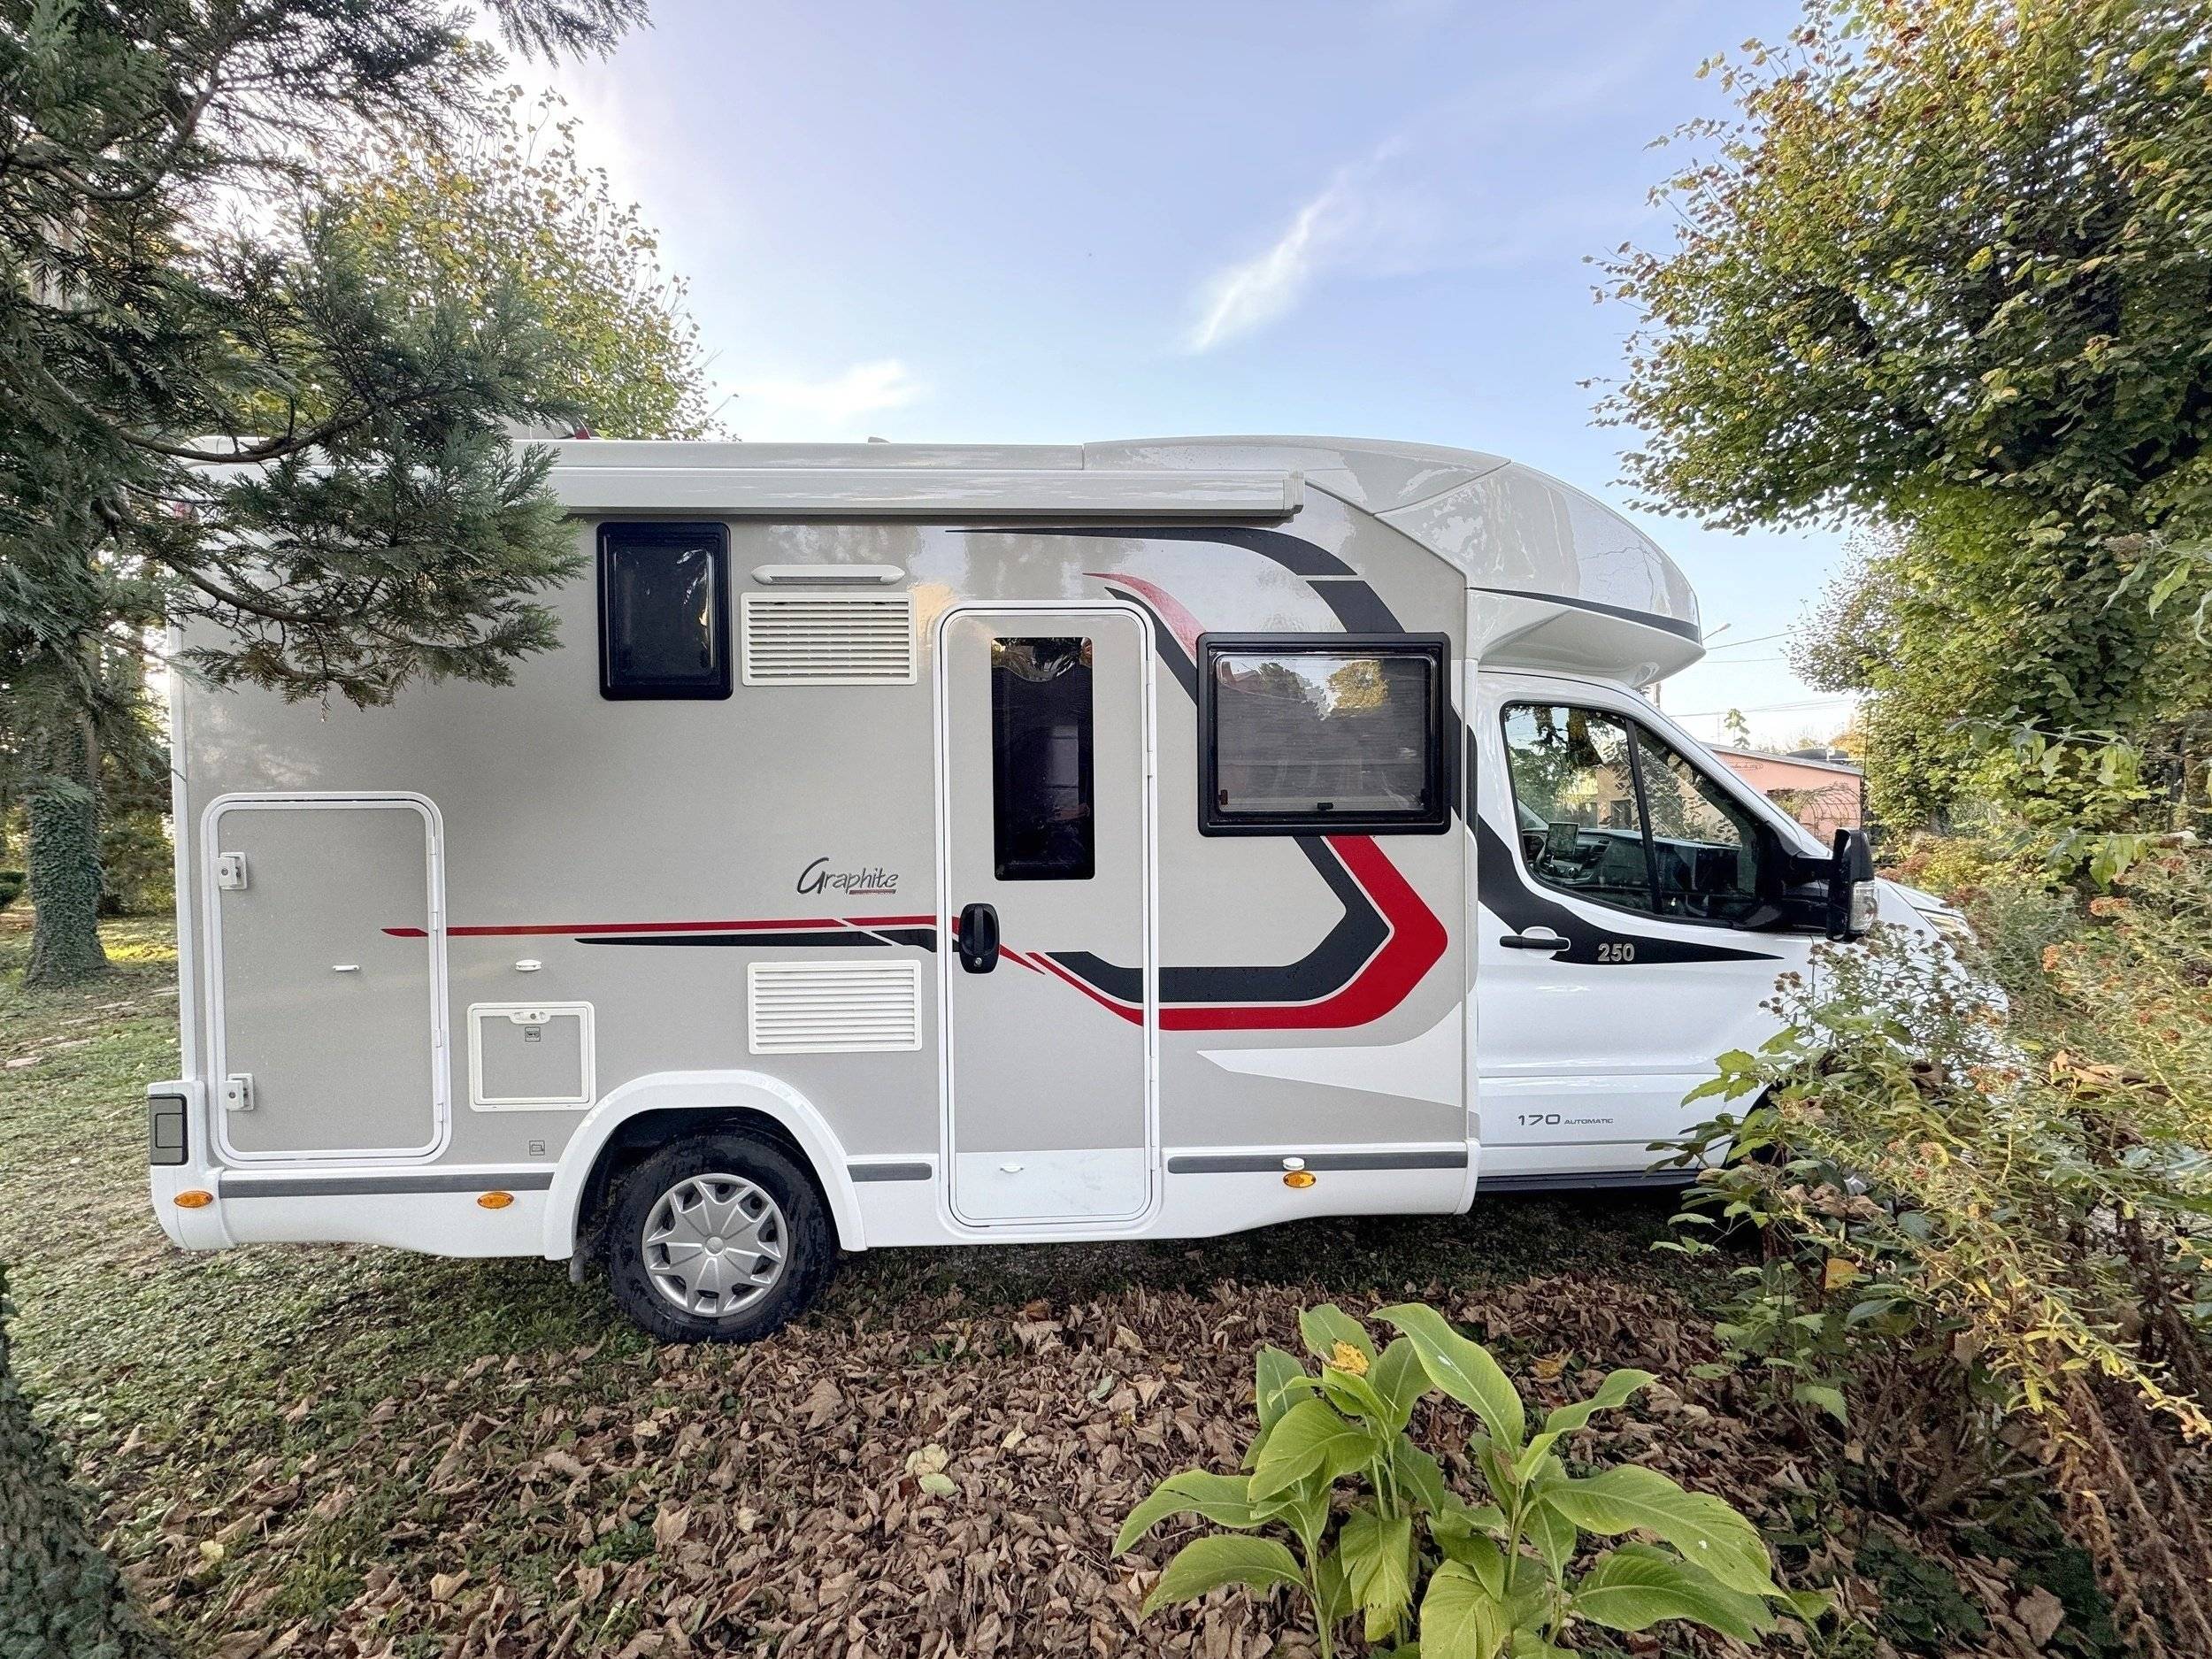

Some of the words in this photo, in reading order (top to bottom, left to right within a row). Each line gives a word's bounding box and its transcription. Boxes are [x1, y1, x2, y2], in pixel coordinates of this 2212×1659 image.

[796, 856, 899, 895] Graphite
[1597, 942, 1635, 962] 250
[1517, 1113, 1561, 1126] 170
